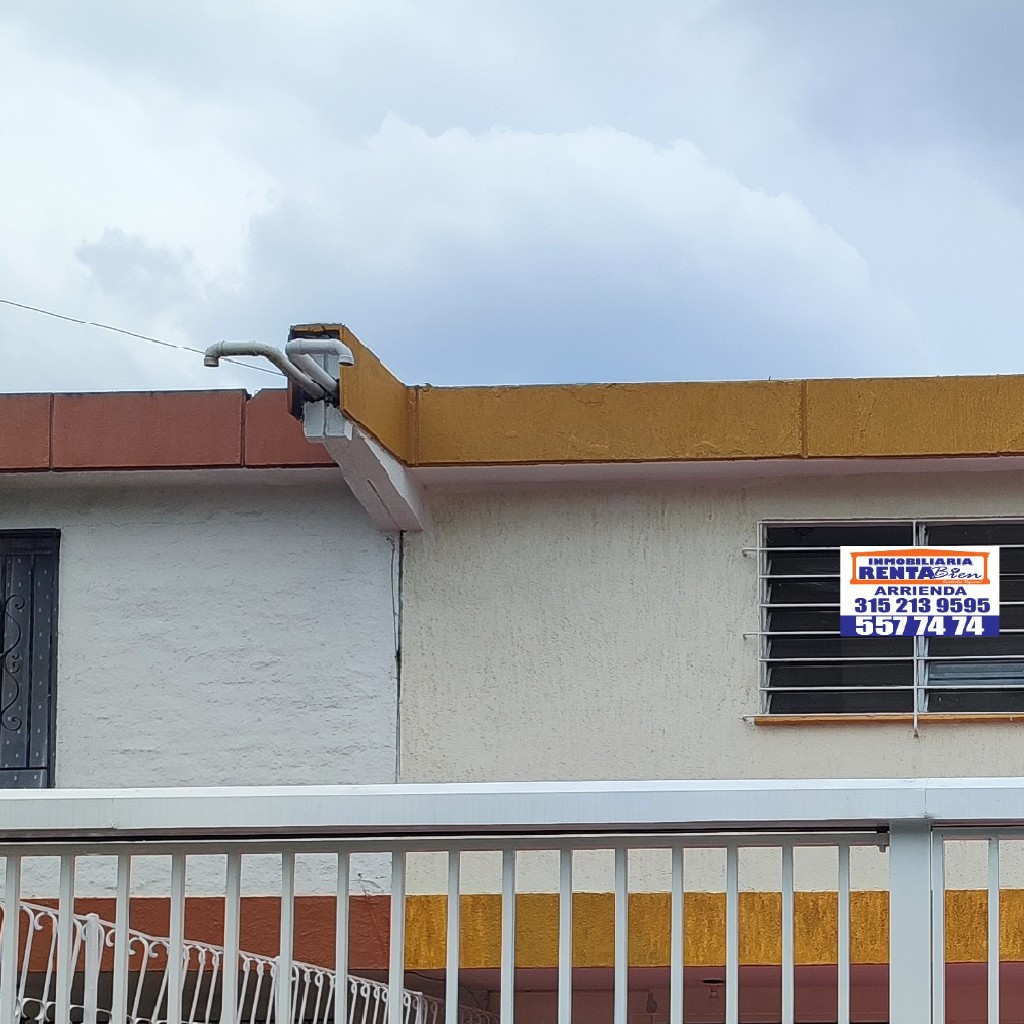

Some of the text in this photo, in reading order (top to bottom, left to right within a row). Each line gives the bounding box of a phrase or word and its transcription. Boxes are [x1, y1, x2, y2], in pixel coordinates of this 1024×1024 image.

[868, 558, 973, 566] INMOBILIARIA
[874, 586, 967, 596] ARRIENDA
[854, 598, 991, 613] 315 213 9595
[855, 616, 985, 636] 557 74 74
